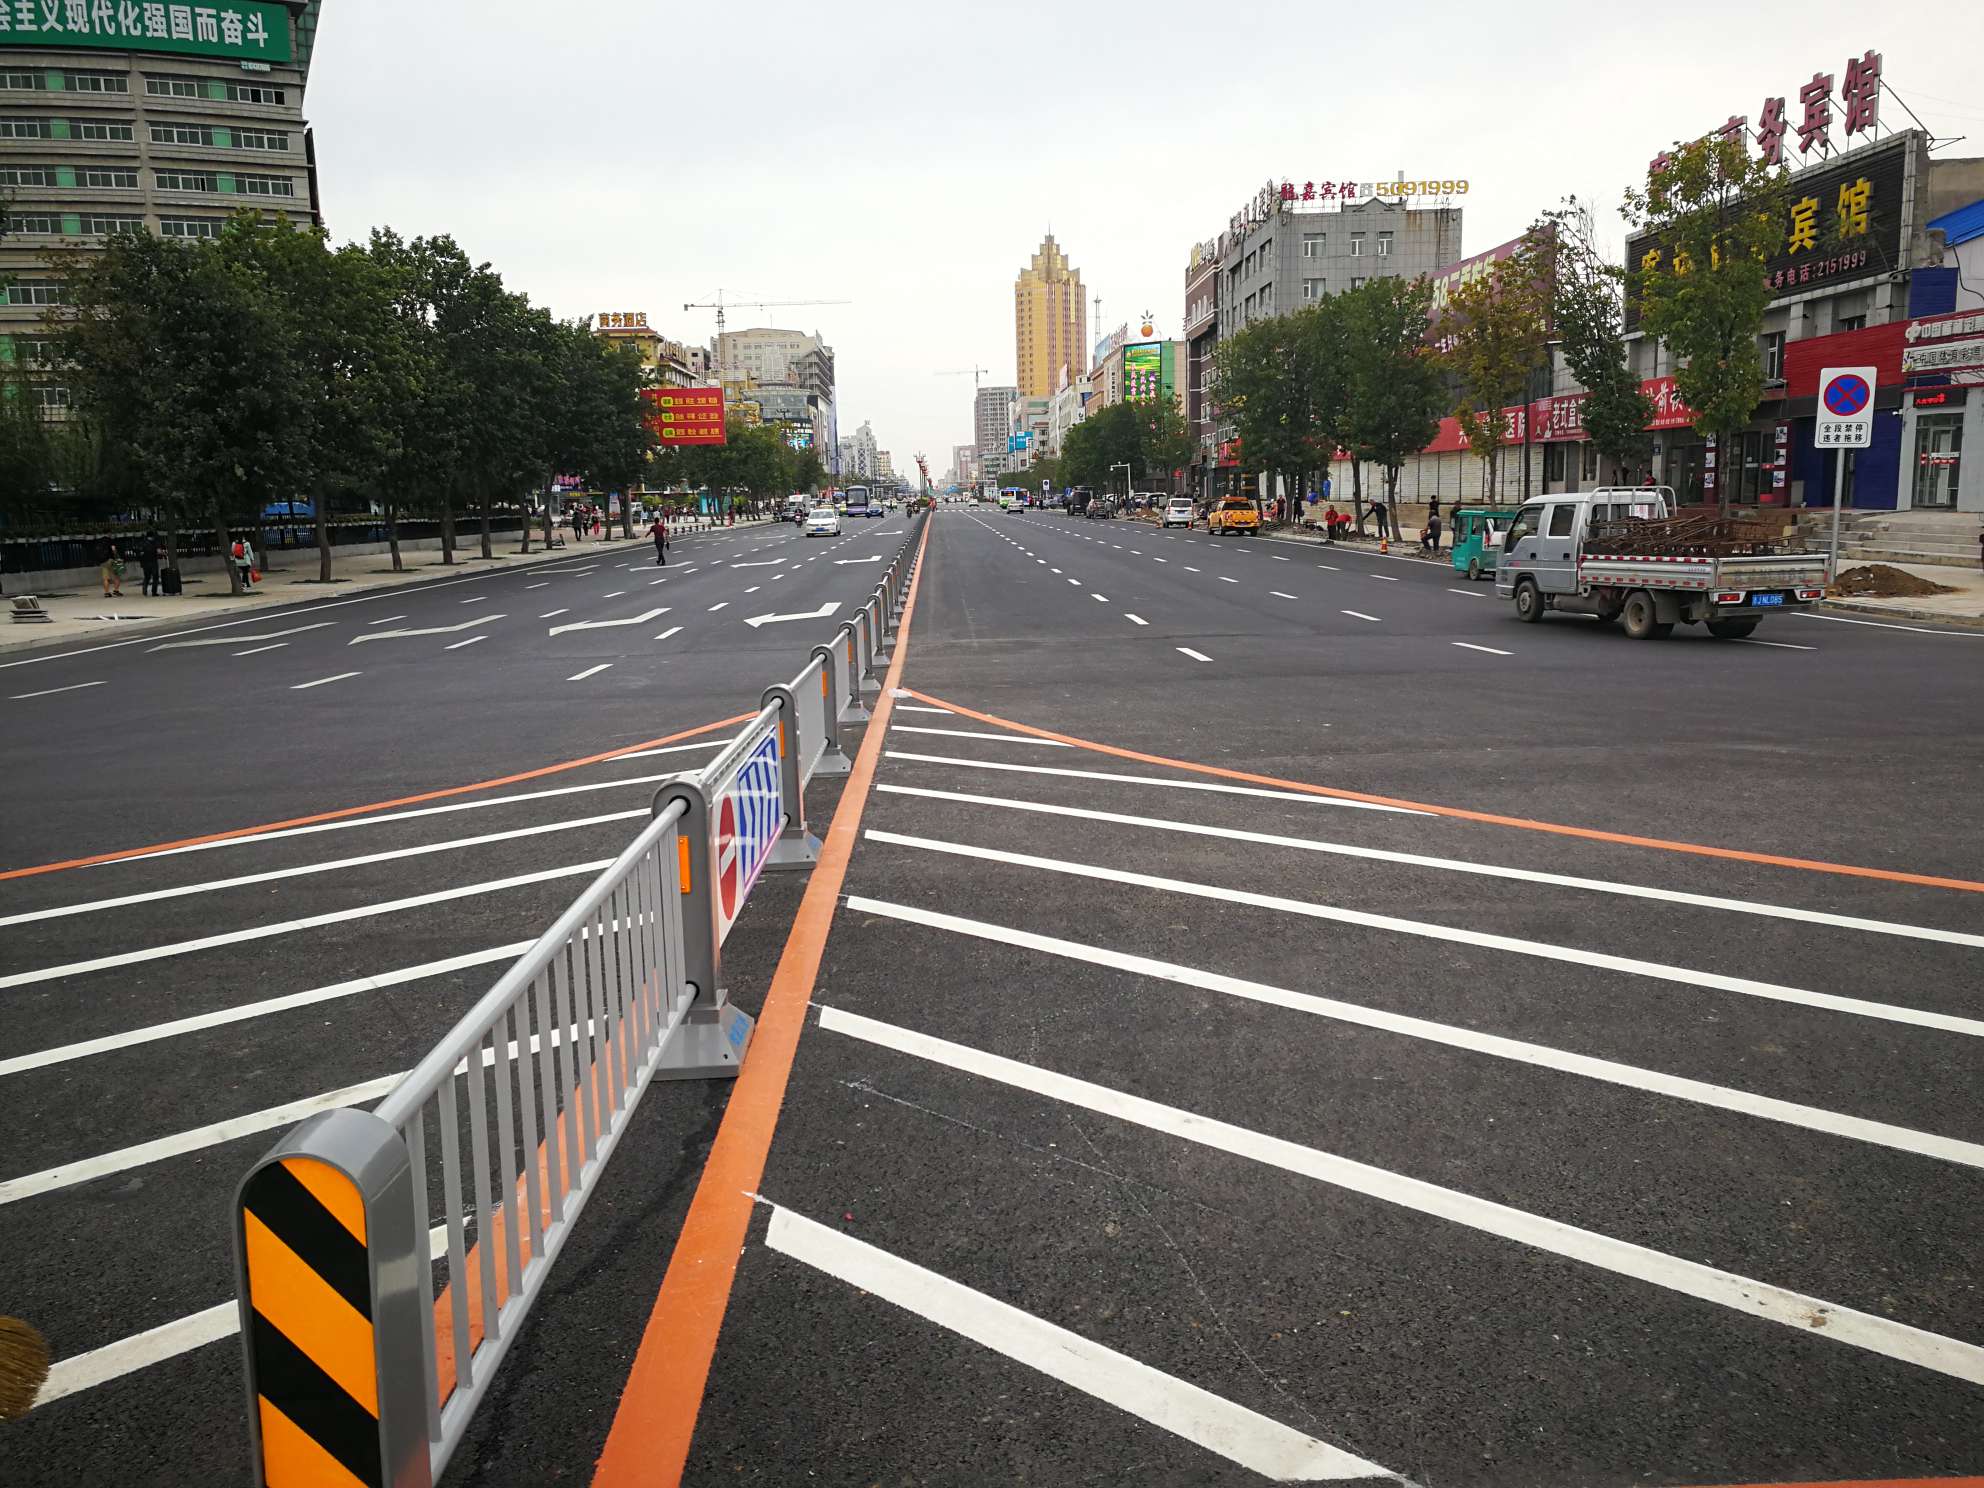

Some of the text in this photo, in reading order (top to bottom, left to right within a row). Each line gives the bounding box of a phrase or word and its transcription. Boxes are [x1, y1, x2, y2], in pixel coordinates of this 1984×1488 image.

[1649, 50, 1882, 202] 务宾馆
[1375, 180, 1470, 196] 5091999
[1823, 423, 1864, 433] 全段禁停
[1822, 433, 1863, 443] 违者拖移
